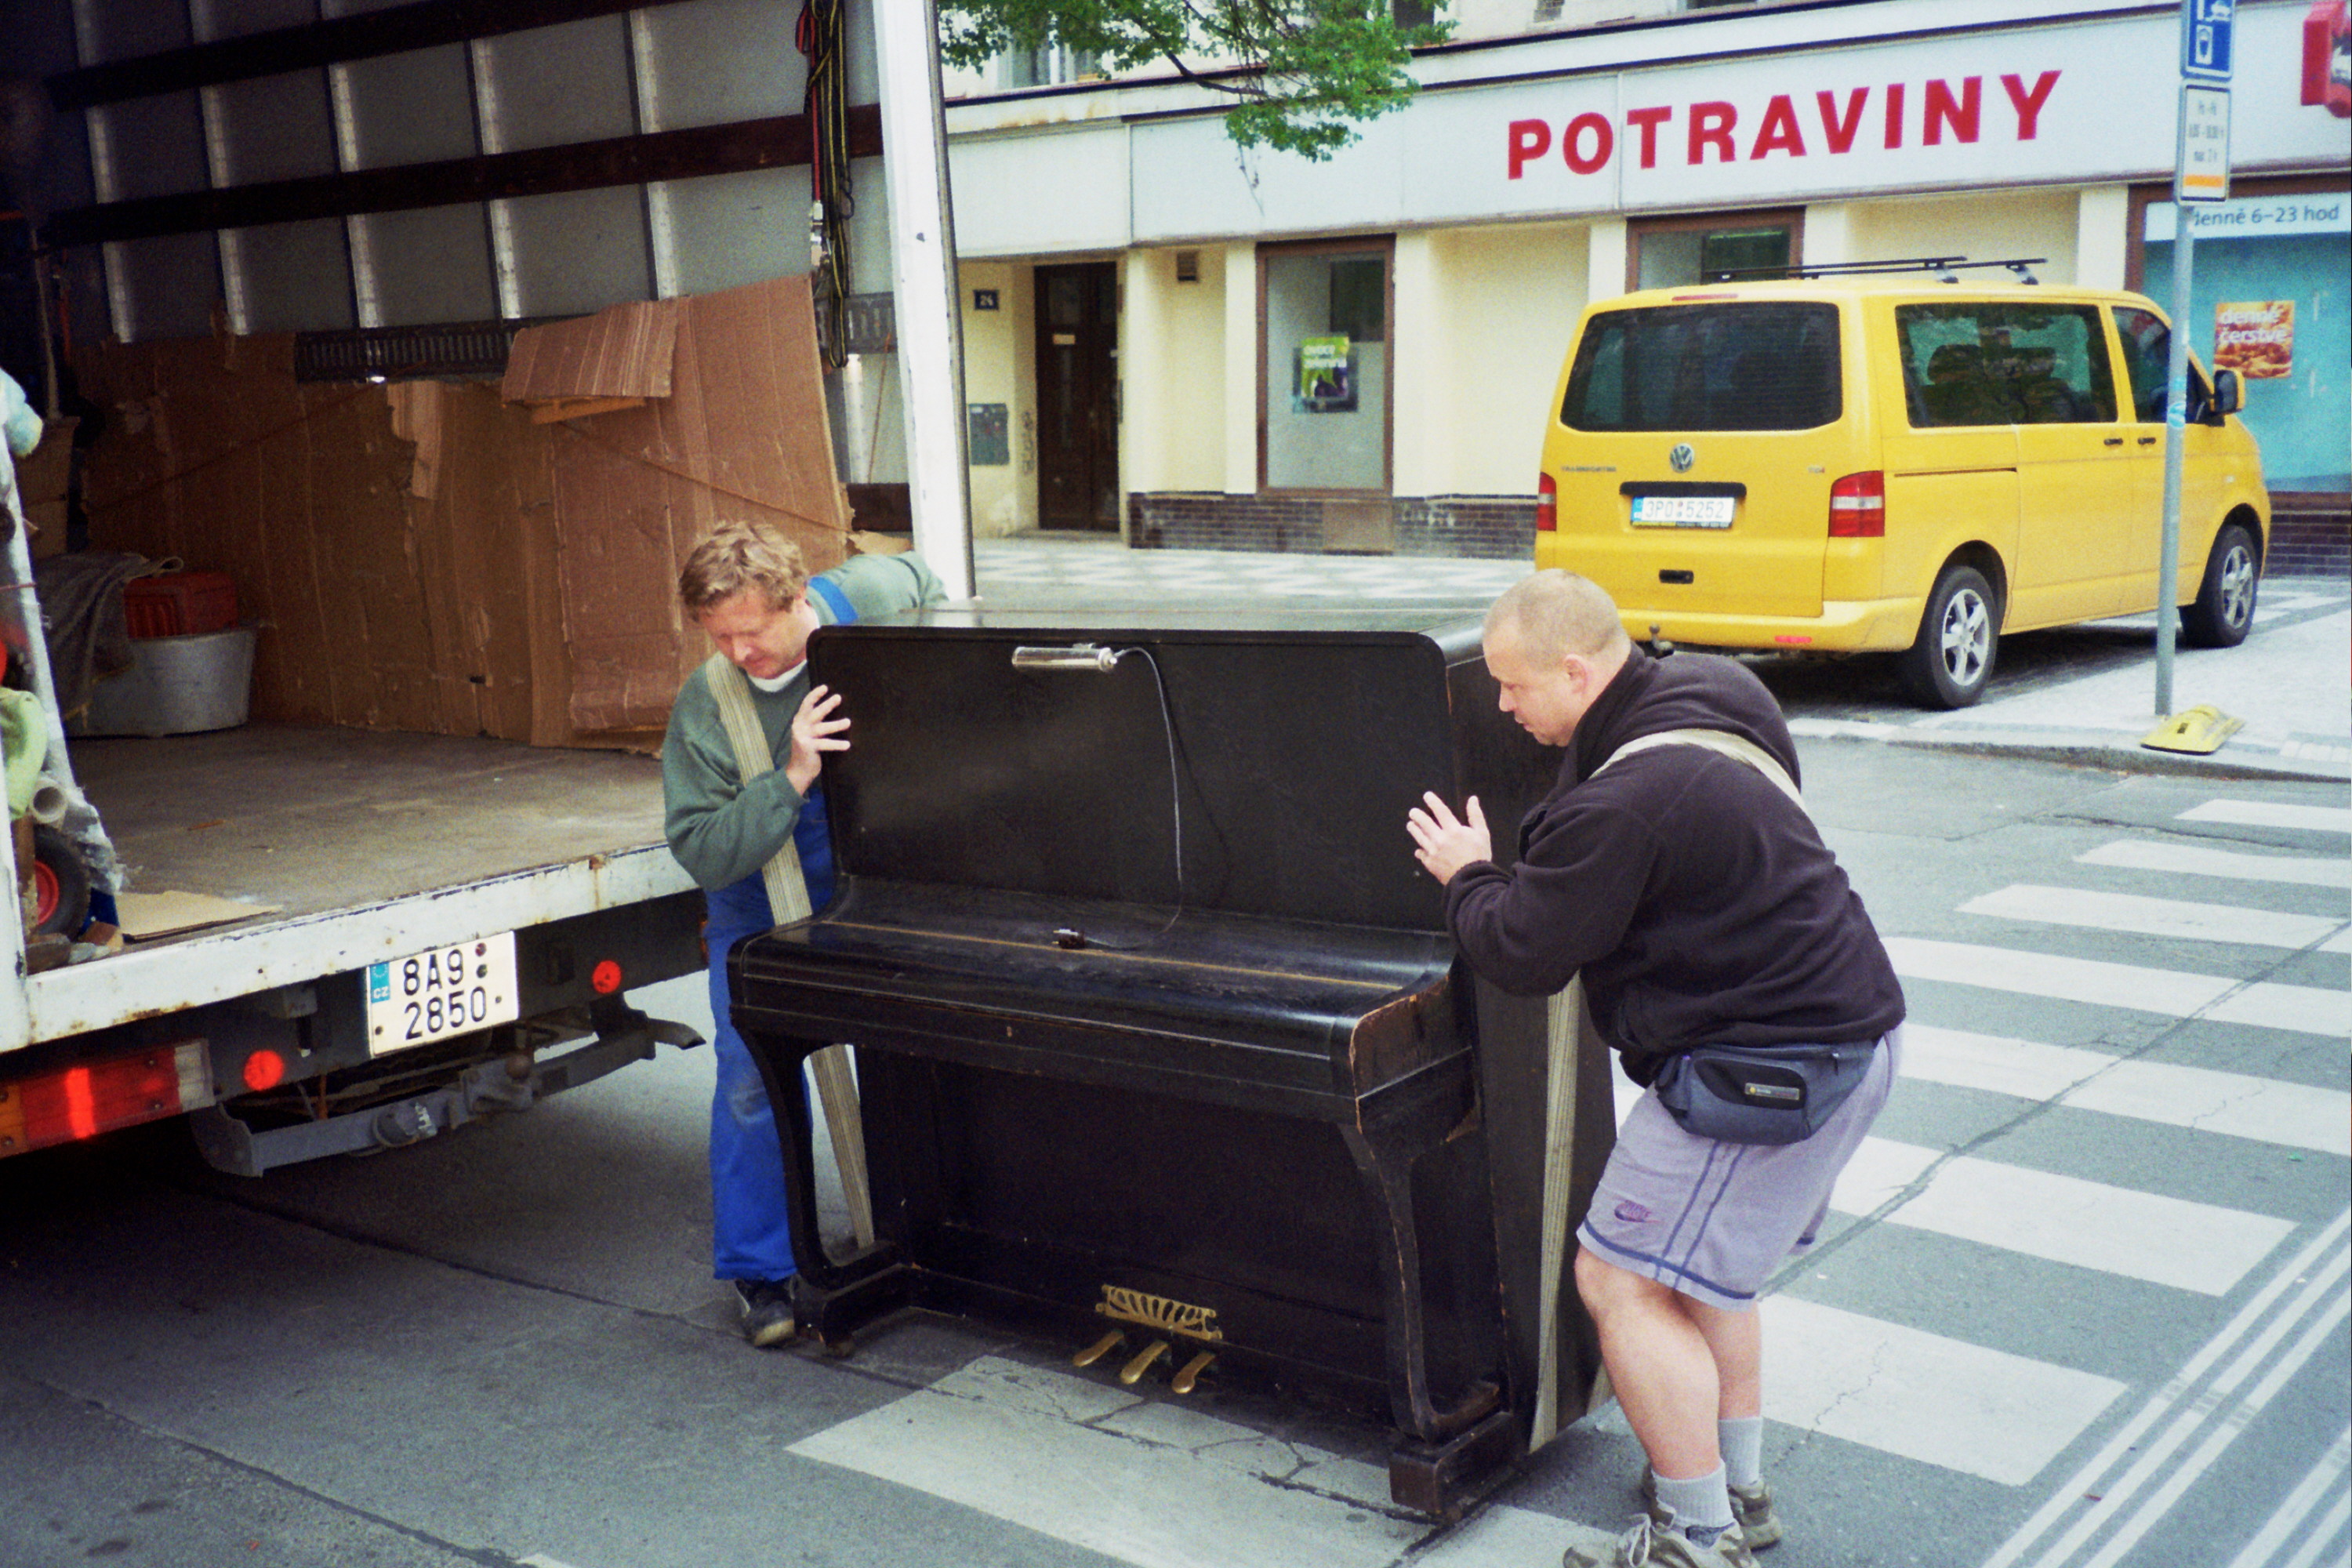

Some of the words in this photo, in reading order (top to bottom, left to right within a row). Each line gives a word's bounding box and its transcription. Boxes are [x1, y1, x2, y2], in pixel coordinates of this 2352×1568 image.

[1508, 69, 2063, 180] POTRAVINY
[2303, 204, 2340, 221] hod
[1686, 500, 1725, 518] 5252
[403, 949, 464, 996] 8A9
[372, 986, 390, 999] CZ
[404, 985, 487, 1040] 2850
